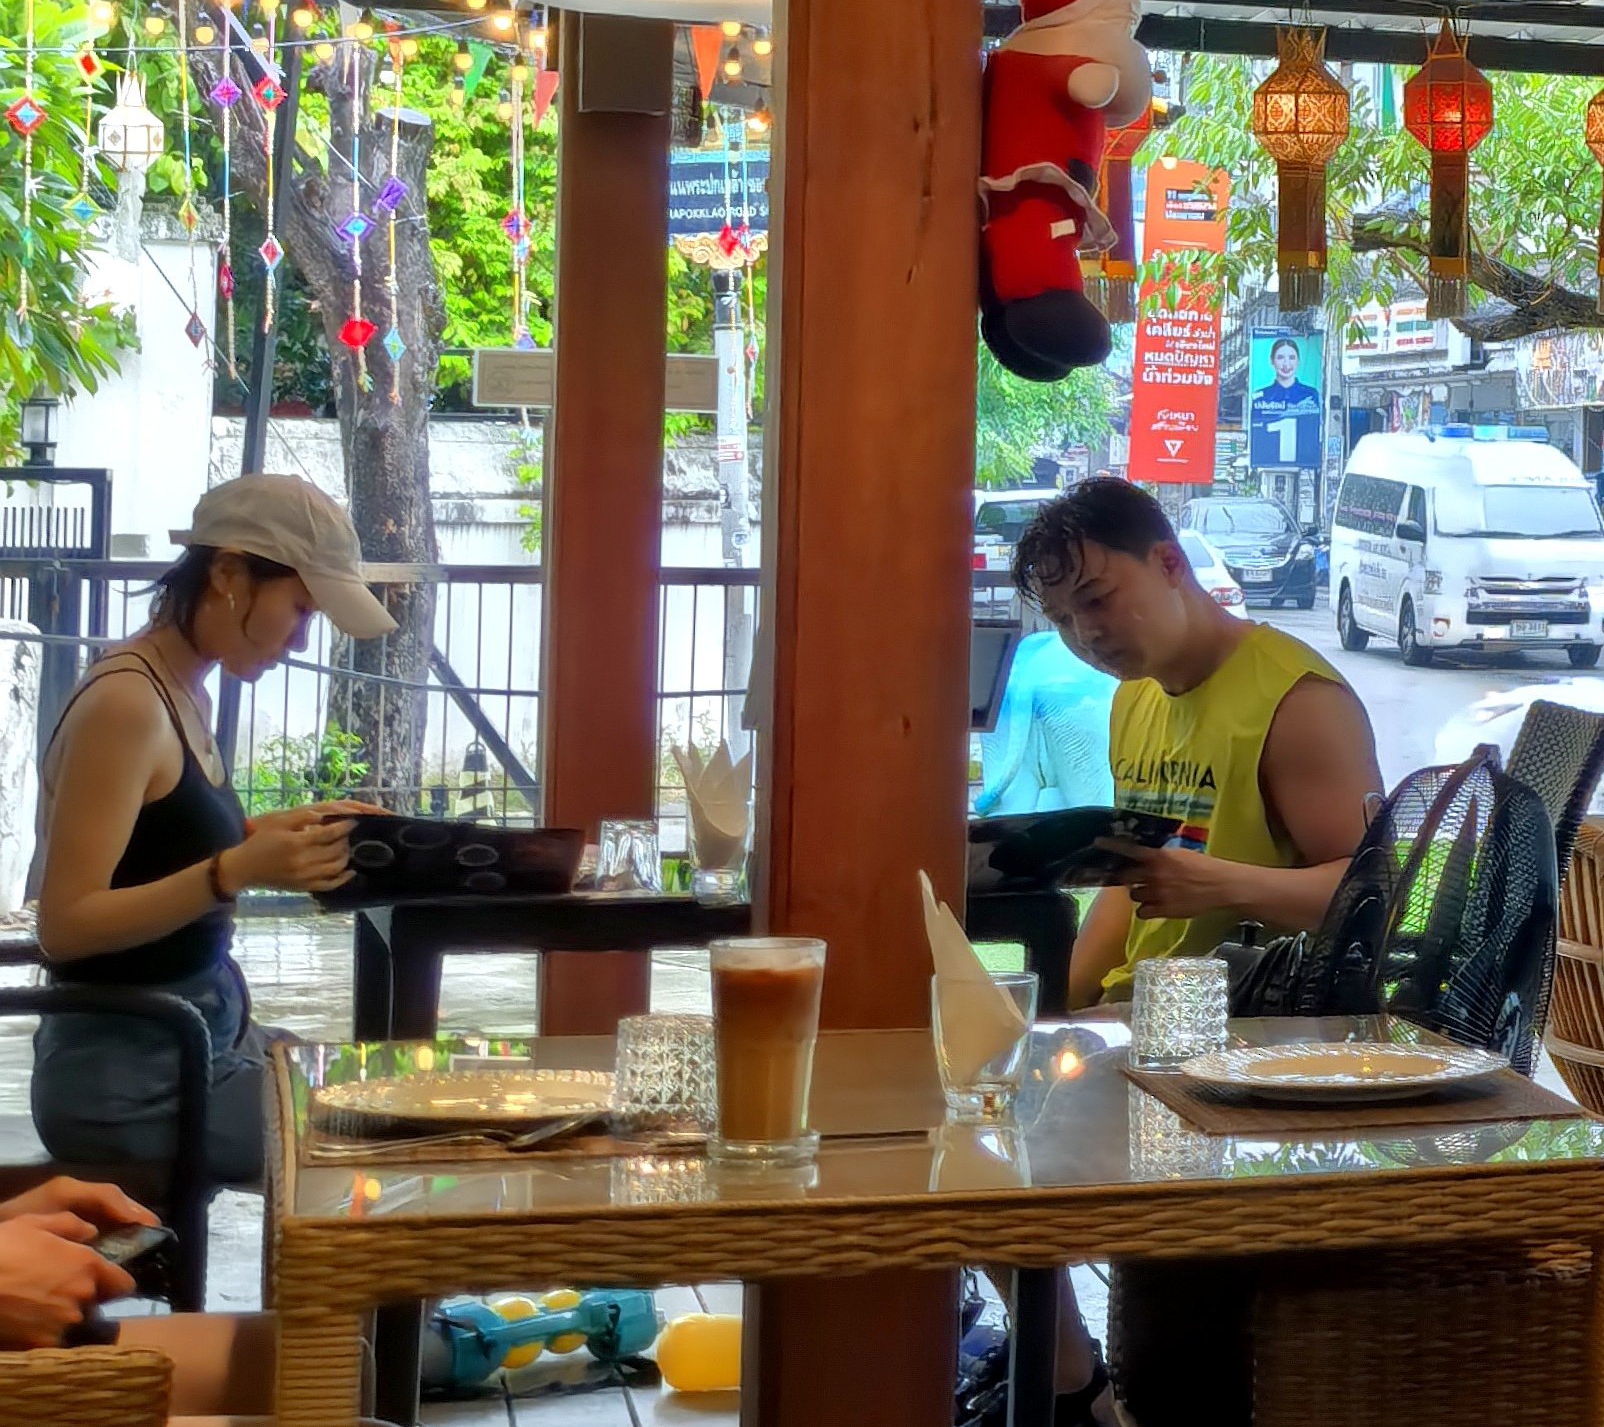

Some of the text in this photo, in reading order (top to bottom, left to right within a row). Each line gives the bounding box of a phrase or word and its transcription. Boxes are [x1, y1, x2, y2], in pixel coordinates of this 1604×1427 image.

[728, 206, 757, 218] ROD
[1266, 418, 1297, 462] 1
[1114, 758, 1217, 790] CALIRNIA
